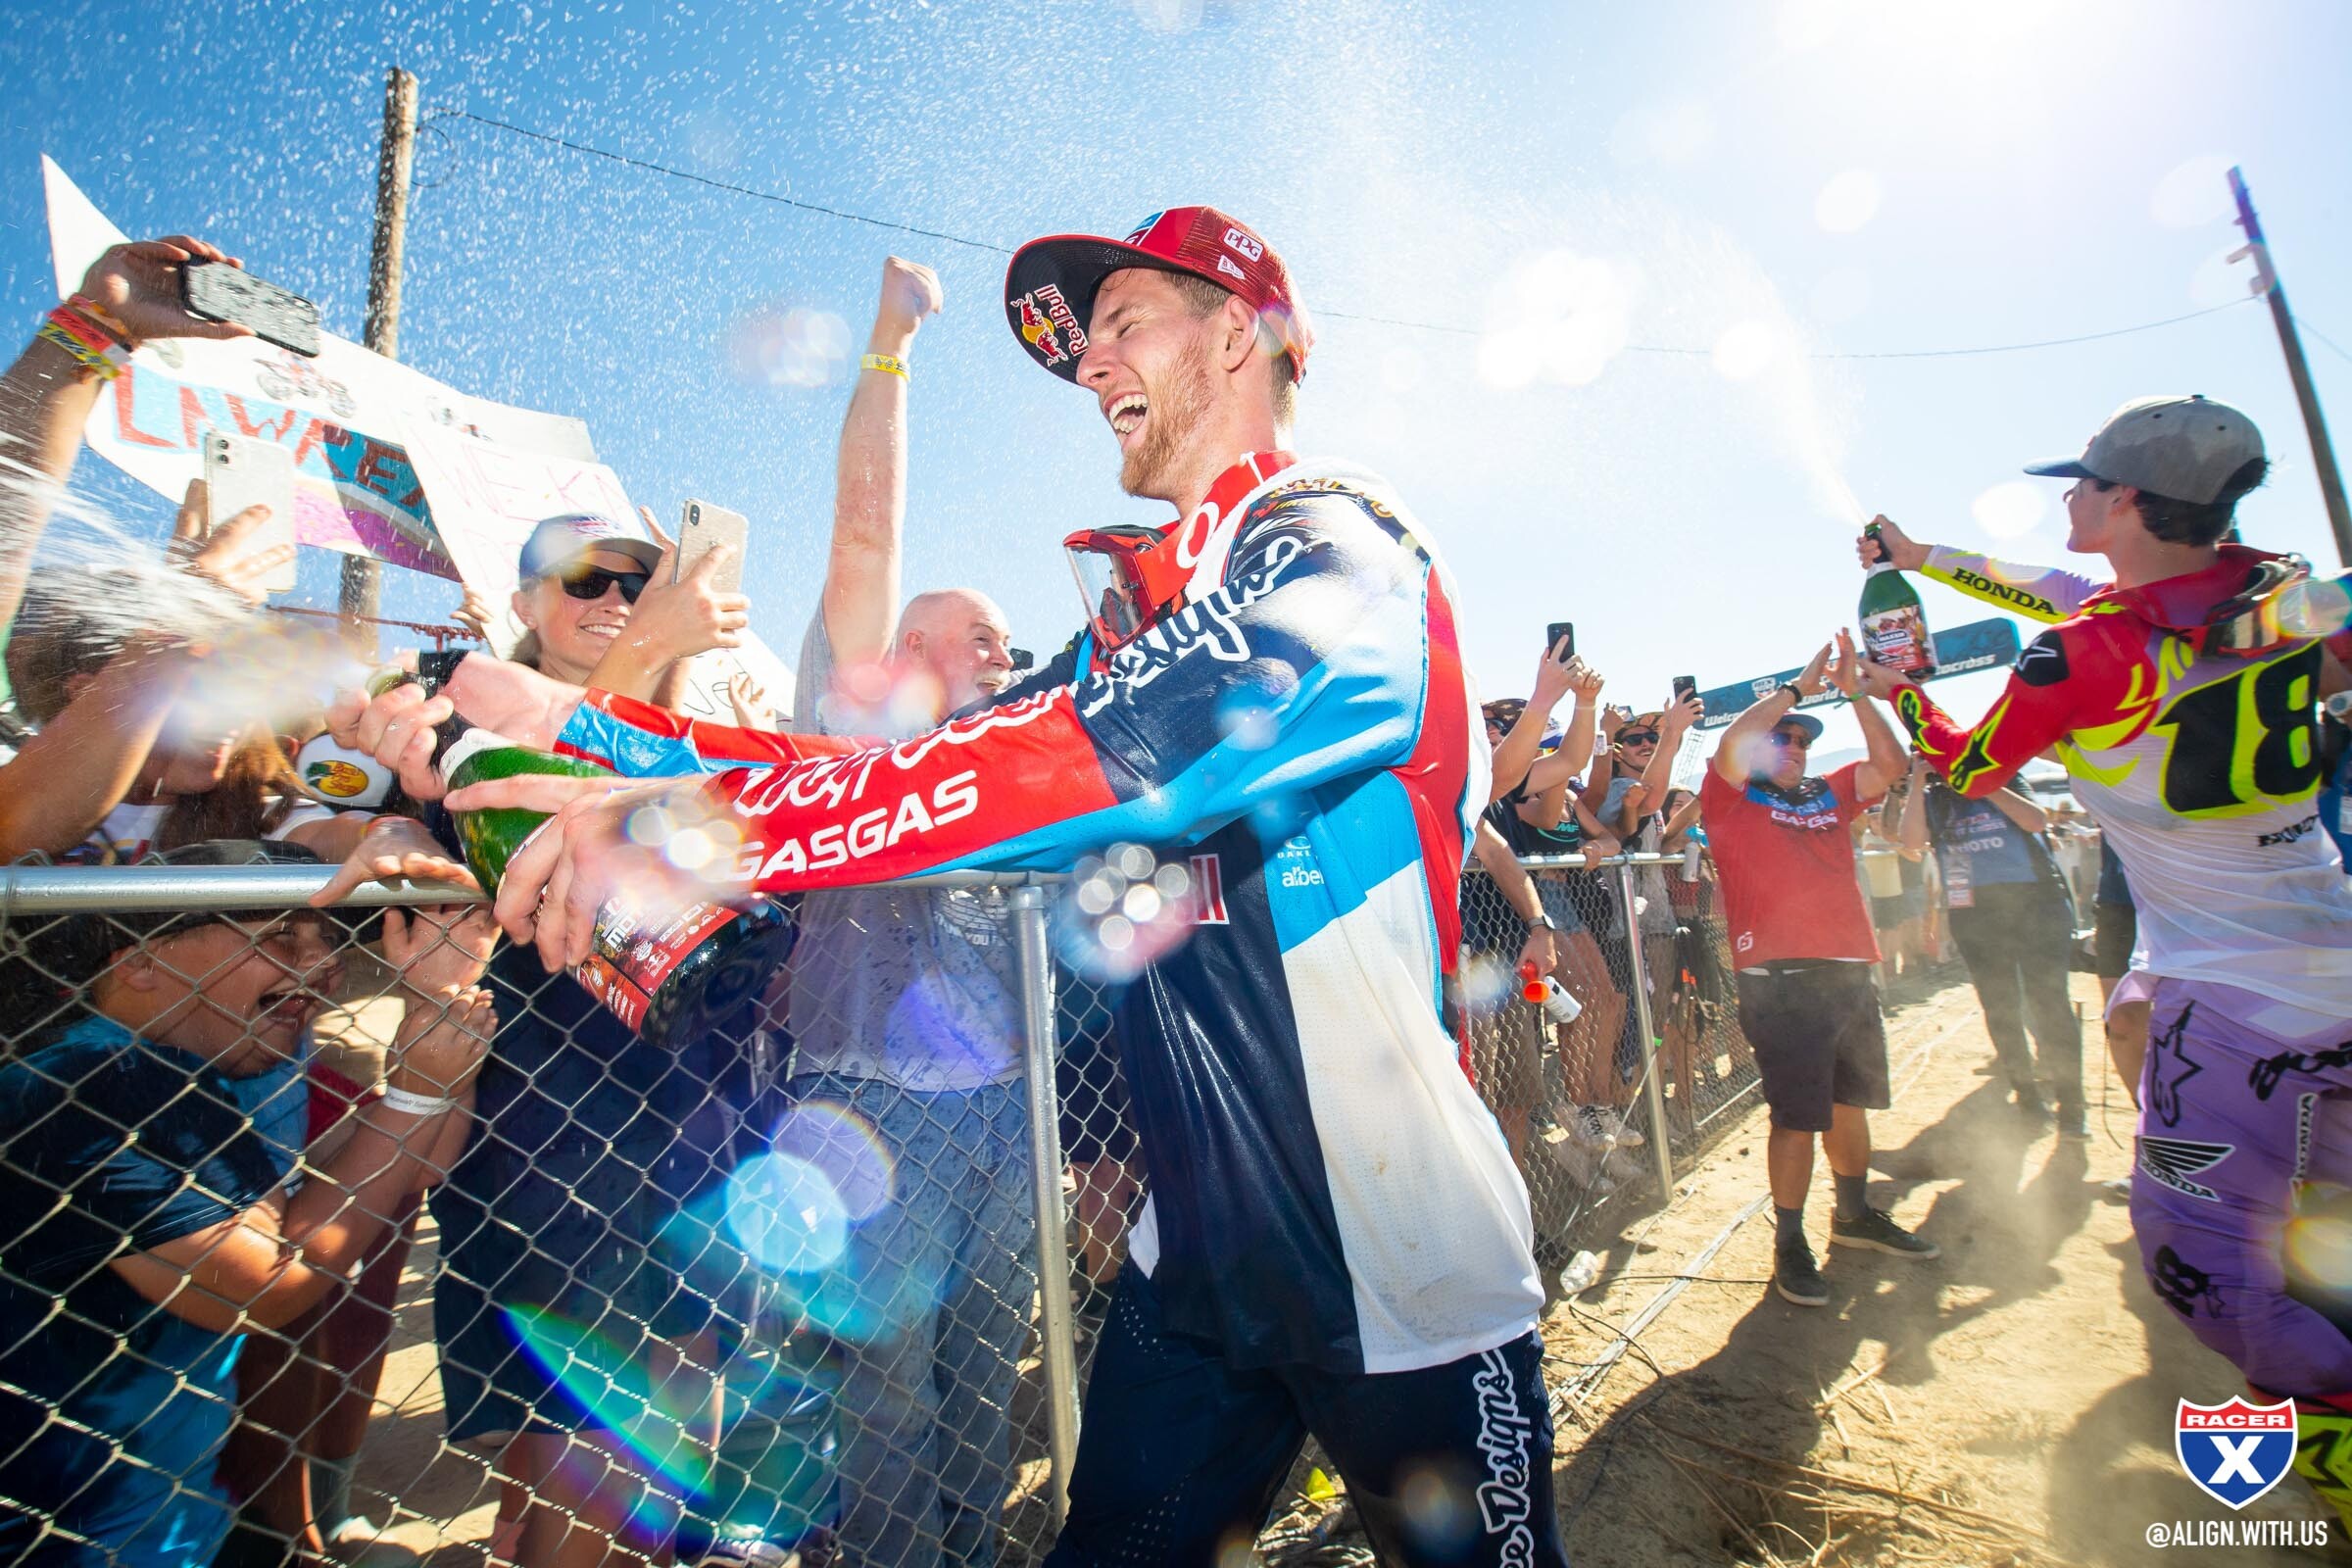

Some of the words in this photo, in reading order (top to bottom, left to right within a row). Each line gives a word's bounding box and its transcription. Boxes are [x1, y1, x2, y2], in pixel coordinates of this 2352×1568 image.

[1227, 229, 1261, 260] PPG
[1952, 567, 2059, 616] HONDA
[2155, 639, 2324, 813] 18
[726, 769, 978, 881] GASGAS
[1472, 1348, 1533, 1535] Designs
